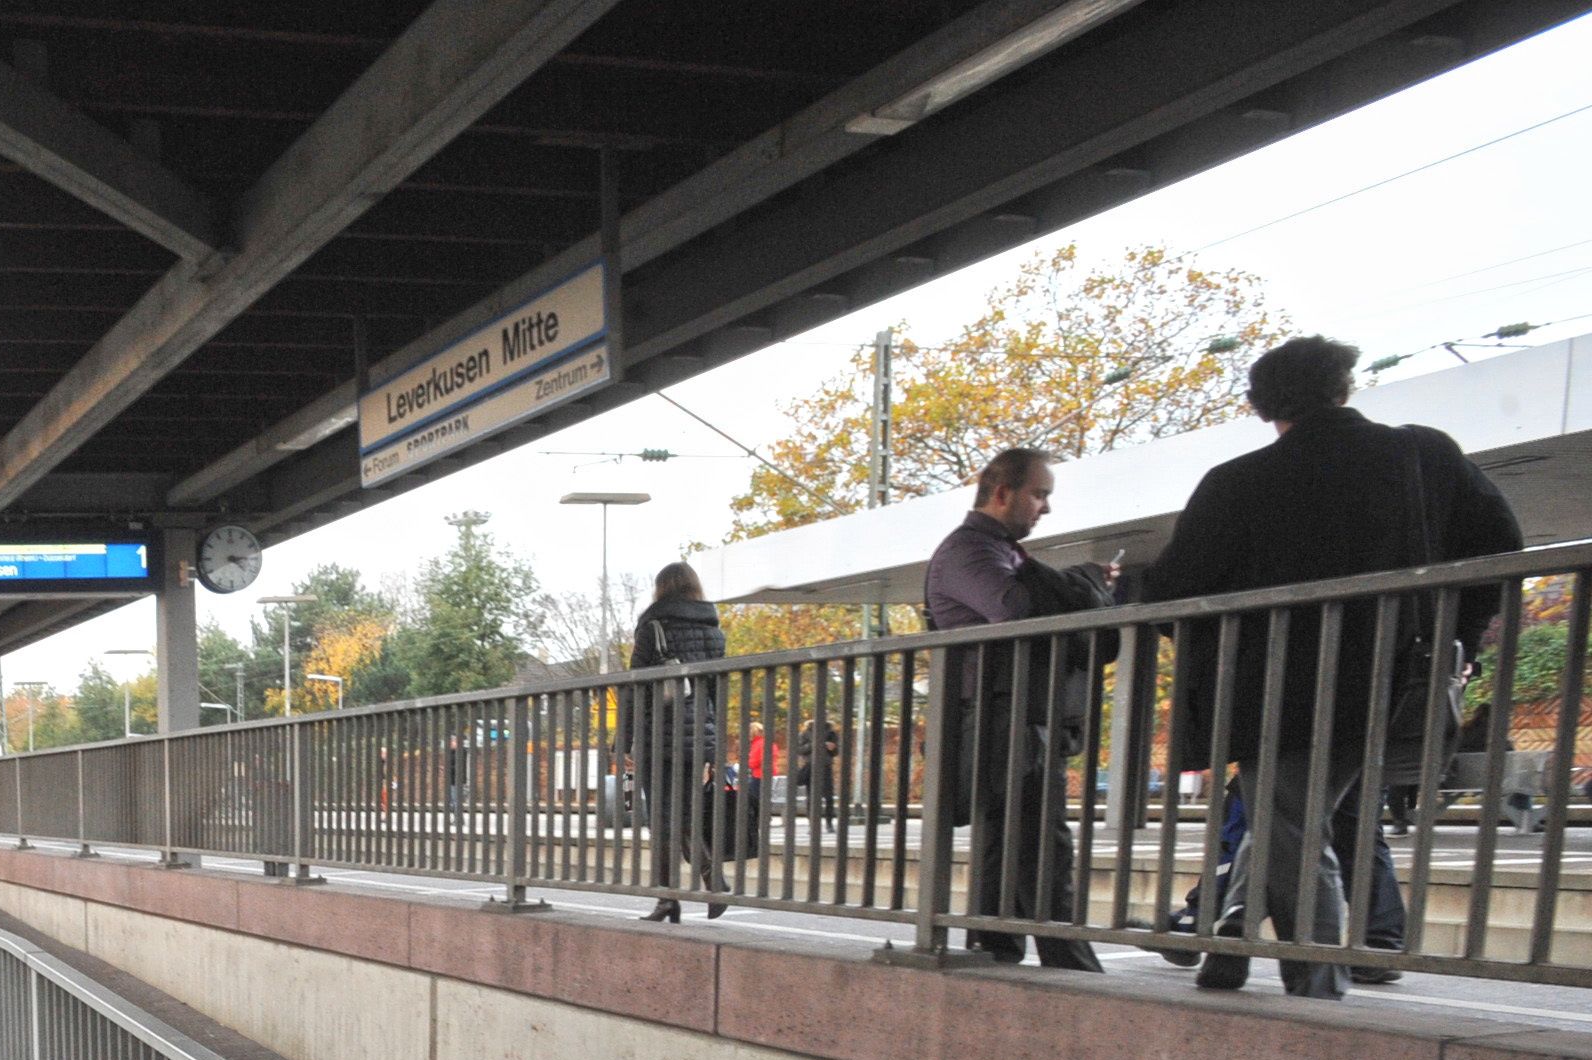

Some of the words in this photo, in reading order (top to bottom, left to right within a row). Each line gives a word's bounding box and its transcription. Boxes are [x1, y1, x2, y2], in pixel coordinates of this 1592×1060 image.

[386, 348, 491, 425] Leverkusen
[501, 310, 560, 366] Mitte
[534, 361, 589, 401] Zentrum
[372, 451, 401, 474] Forum
[136, 545, 148, 569] 1
